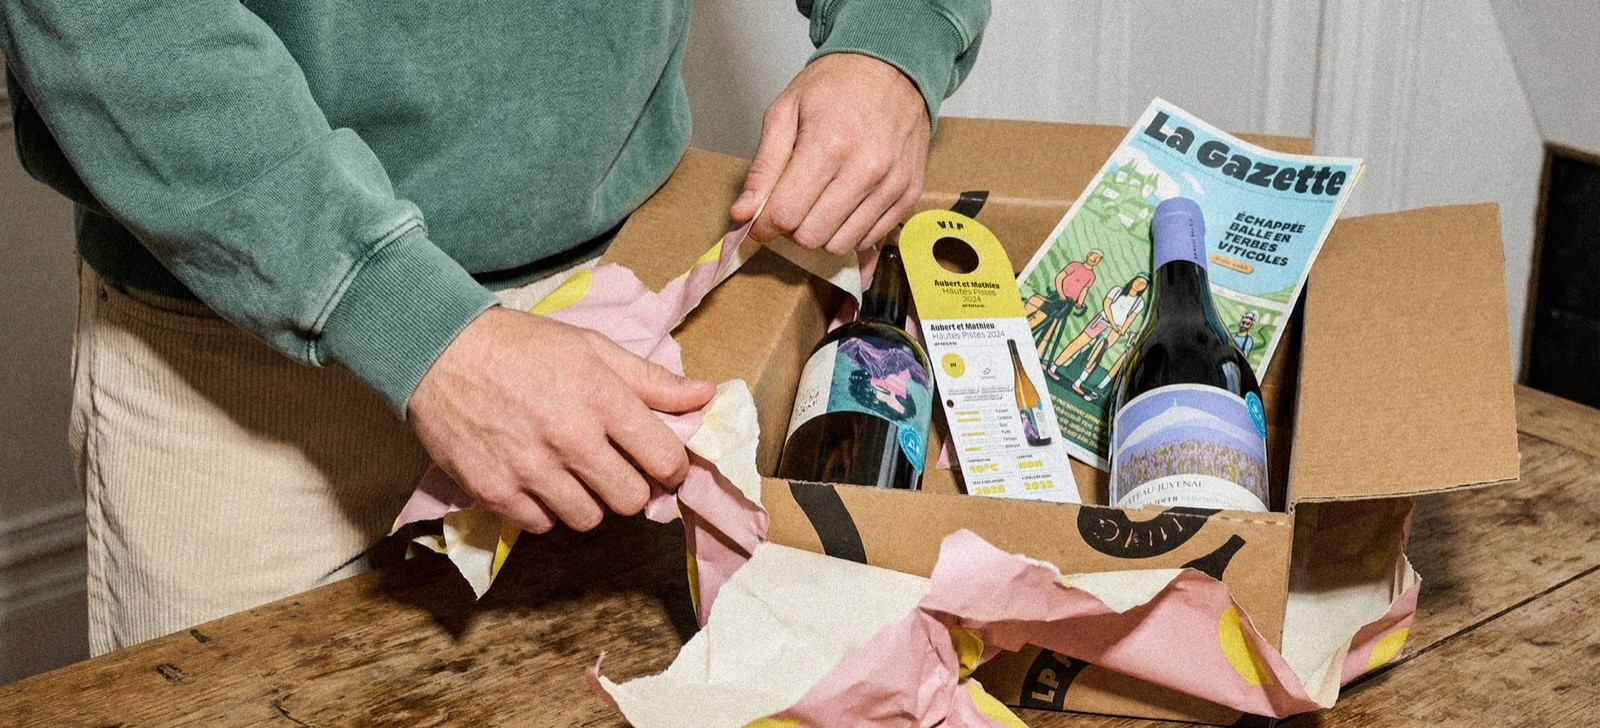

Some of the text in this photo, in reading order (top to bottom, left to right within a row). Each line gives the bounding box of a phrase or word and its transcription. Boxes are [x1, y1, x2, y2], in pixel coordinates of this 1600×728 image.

[1143, 111, 1195, 155] La
[1196, 140, 1347, 196] Gazette
[1235, 211, 1306, 233] ÉCHAPPÉE
[1229, 222, 1292, 243] BALLE EN
[1218, 241, 1289, 266] VITICOLES
[934, 280, 961, 288] Aubert
[971, 281, 1000, 289] Mathieu
[942, 288, 997, 296] Hautes Pistes
[930, 322, 995, 331] Aubert et Mathieu
[932, 330, 1005, 340] Hautes Pistes 2024
